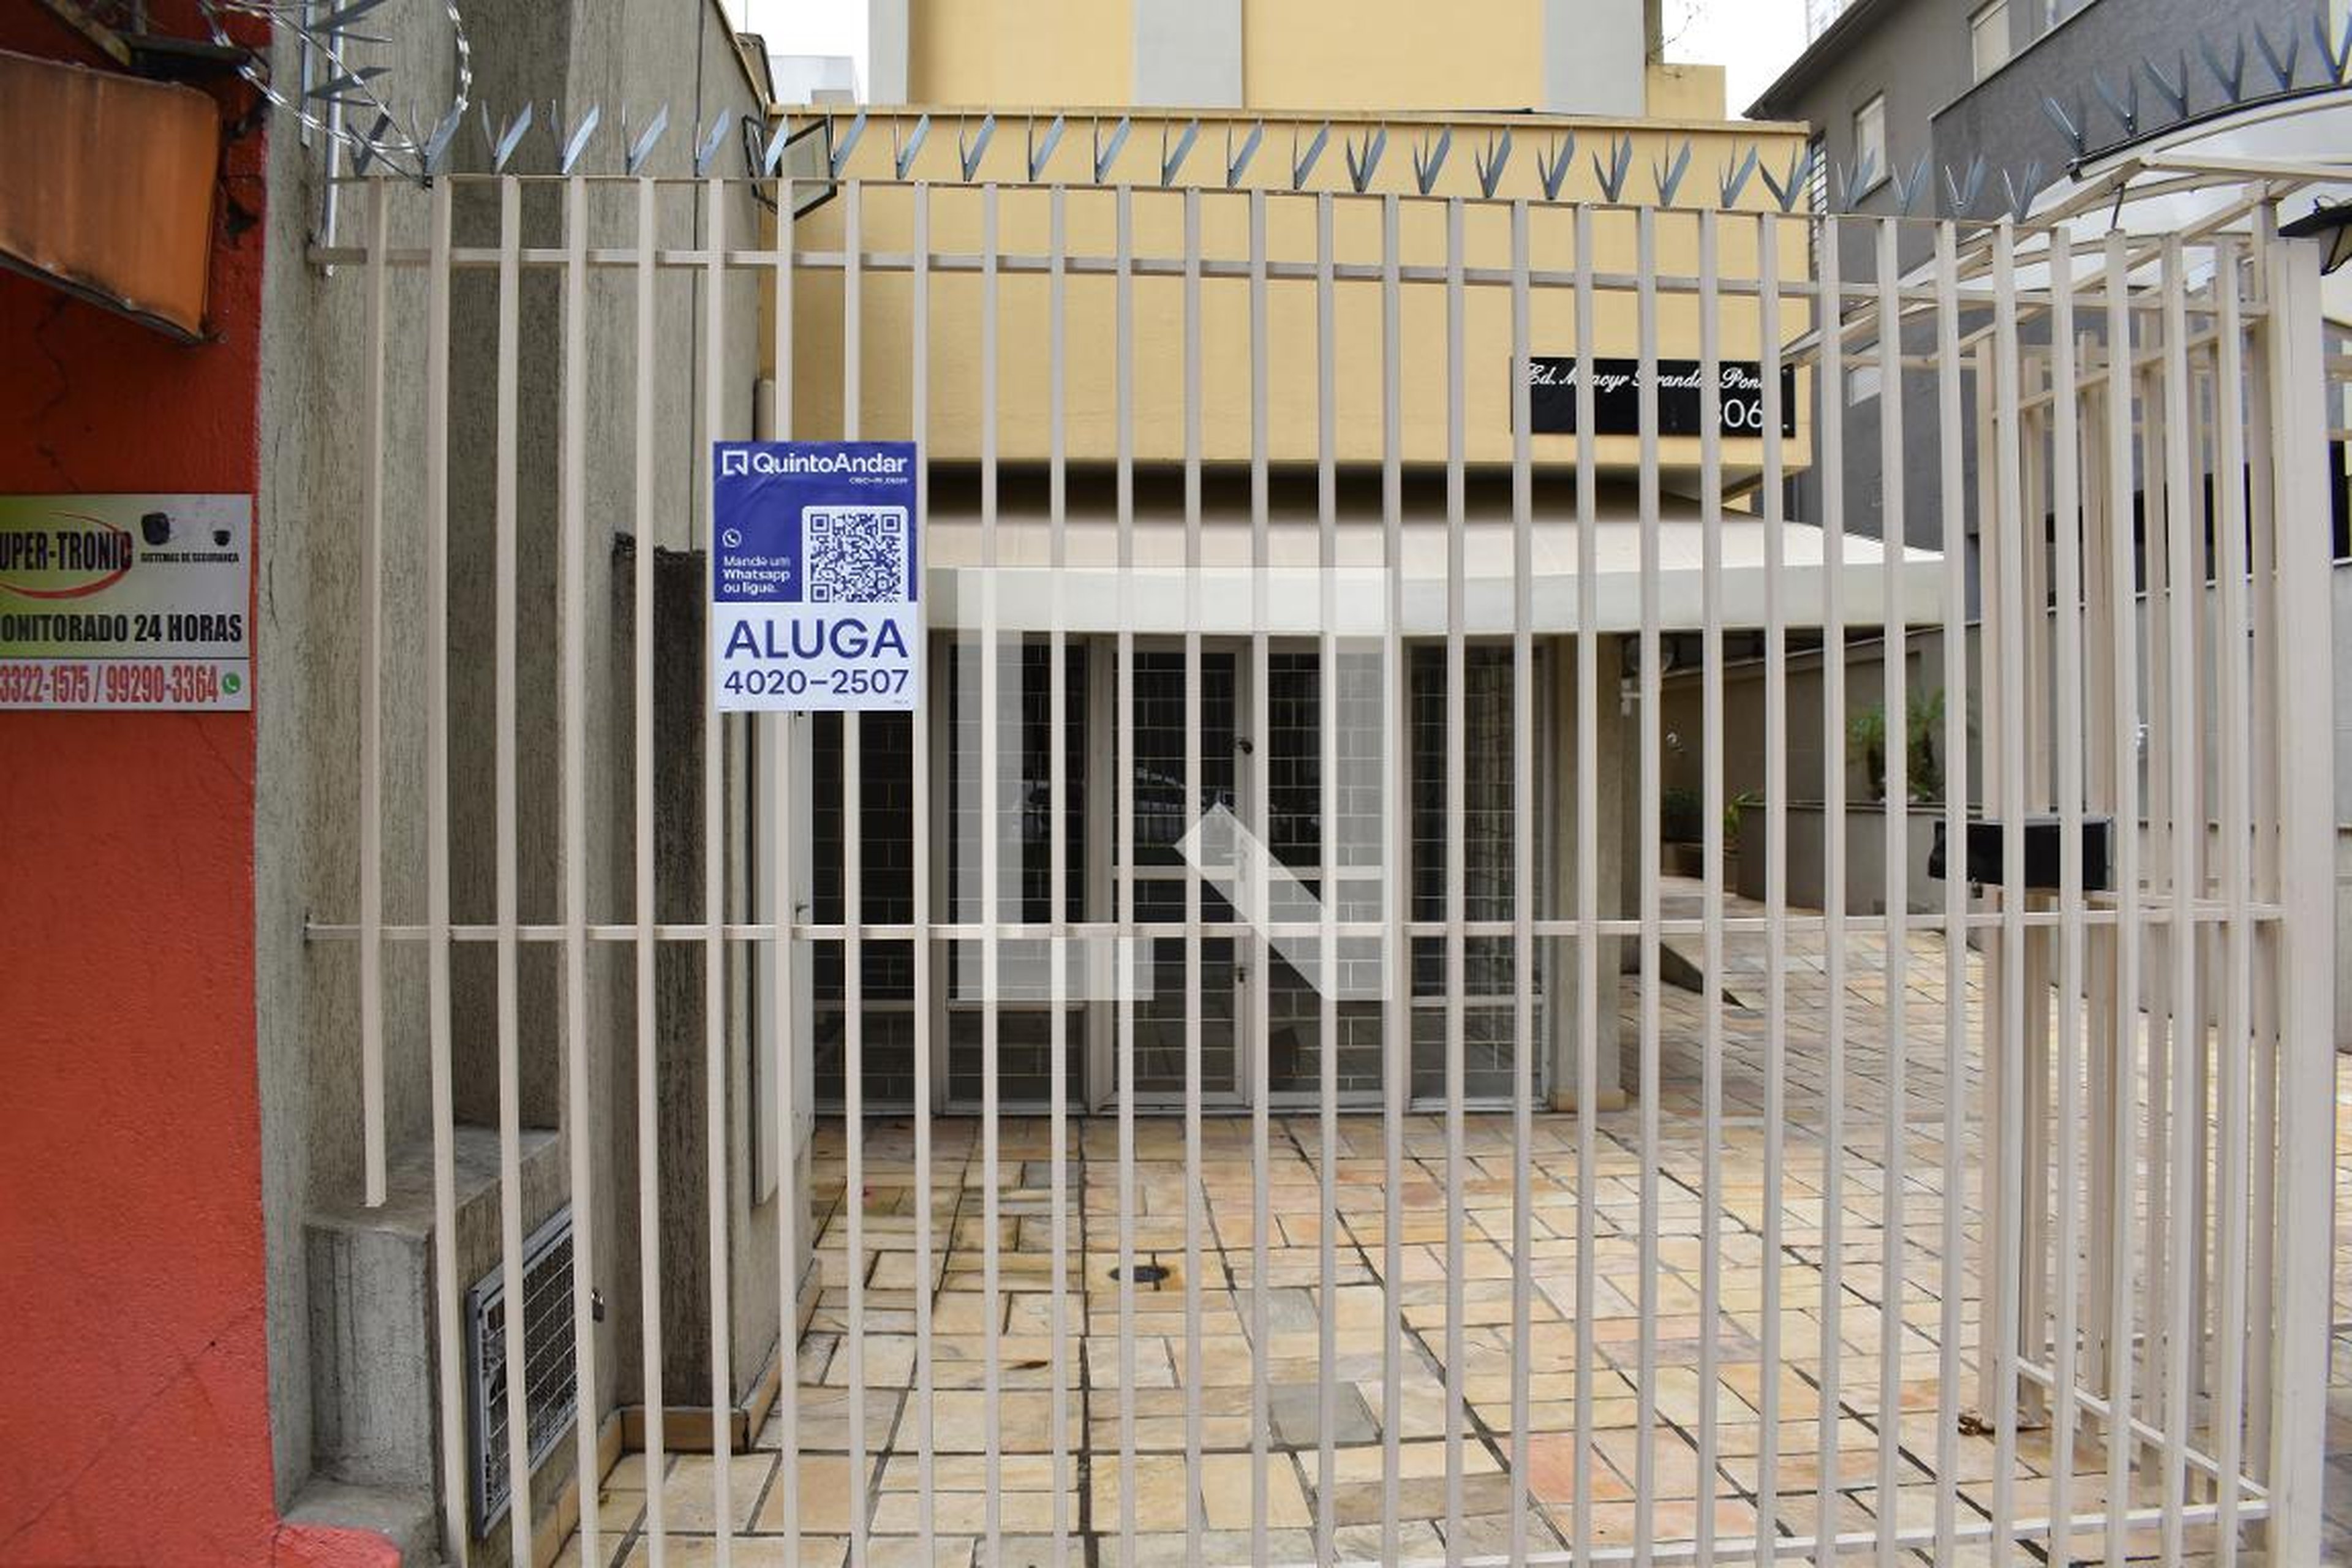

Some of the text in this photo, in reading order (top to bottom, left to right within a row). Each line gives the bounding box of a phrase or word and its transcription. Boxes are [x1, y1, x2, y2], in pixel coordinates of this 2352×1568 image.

[1714, 398, 1765, 428] 06
[753, 452, 908, 474] QuintoAndar
[724, 583, 740, 593] ou
[134, 614, 162, 642] 24
[168, 614, 243, 642] HORAS
[724, 619, 908, 659] ALUGA
[106, 665, 219, 703] 99290-3364
[724, 669, 909, 695] 4020-2507
